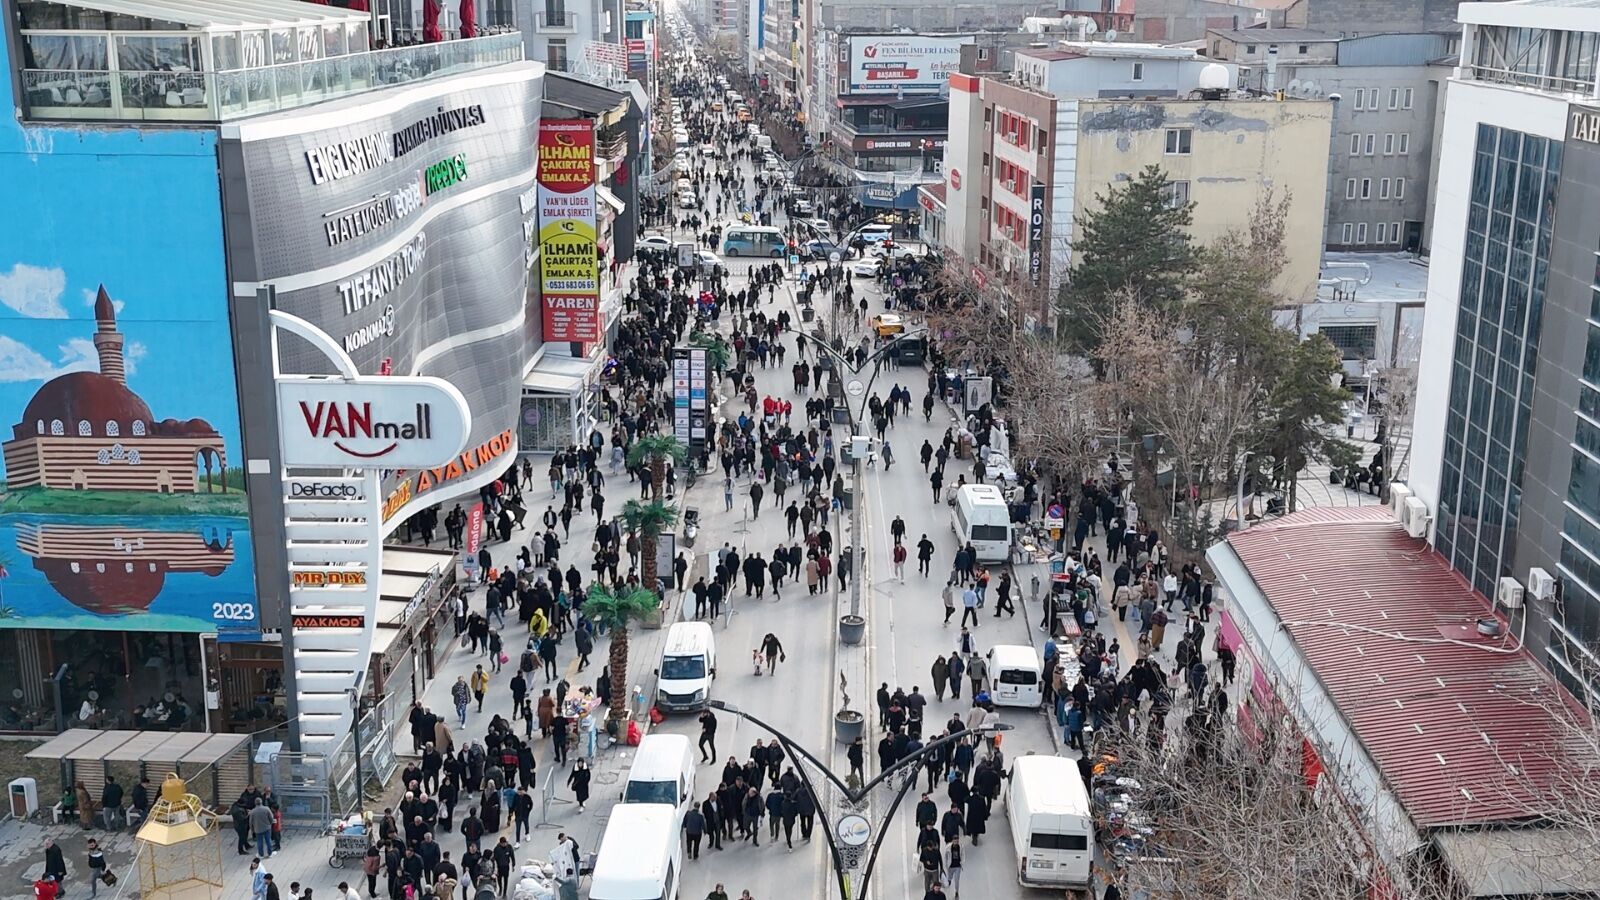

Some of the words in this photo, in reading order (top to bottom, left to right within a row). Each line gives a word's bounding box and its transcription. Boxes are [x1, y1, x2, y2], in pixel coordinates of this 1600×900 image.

[433, 104, 486, 139] DÜNYASI
[304, 138, 367, 185] ENGLISH
[541, 160, 591, 173] ÇAKIRTAŞ
[541, 173, 573, 182] EMLAK
[573, 173, 591, 185] A.Ş.
[569, 195, 589, 206] LİDER
[543, 208, 566, 217] EMLAK
[567, 207, 593, 218] ŞİRKETİ
[1032, 198, 1043, 241] ROZ
[544, 241, 594, 256] İLHAMİ
[545, 256, 594, 268] ÇAKIRTAŞ
[1033, 251, 1041, 288] HOTEL
[546, 269, 575, 278] EMLAK
[576, 269, 594, 280] A.Ş.
[336, 260, 395, 318] TIFFANY
[546, 297, 595, 309] YAREN
[343, 315, 387, 354] KORKMAZ
[416, 430, 513, 494] AYAKMOD
[291, 482, 357, 497] DeFacto
[212, 602, 255, 621] 2023
[293, 617, 363, 627] AYAKMOD
